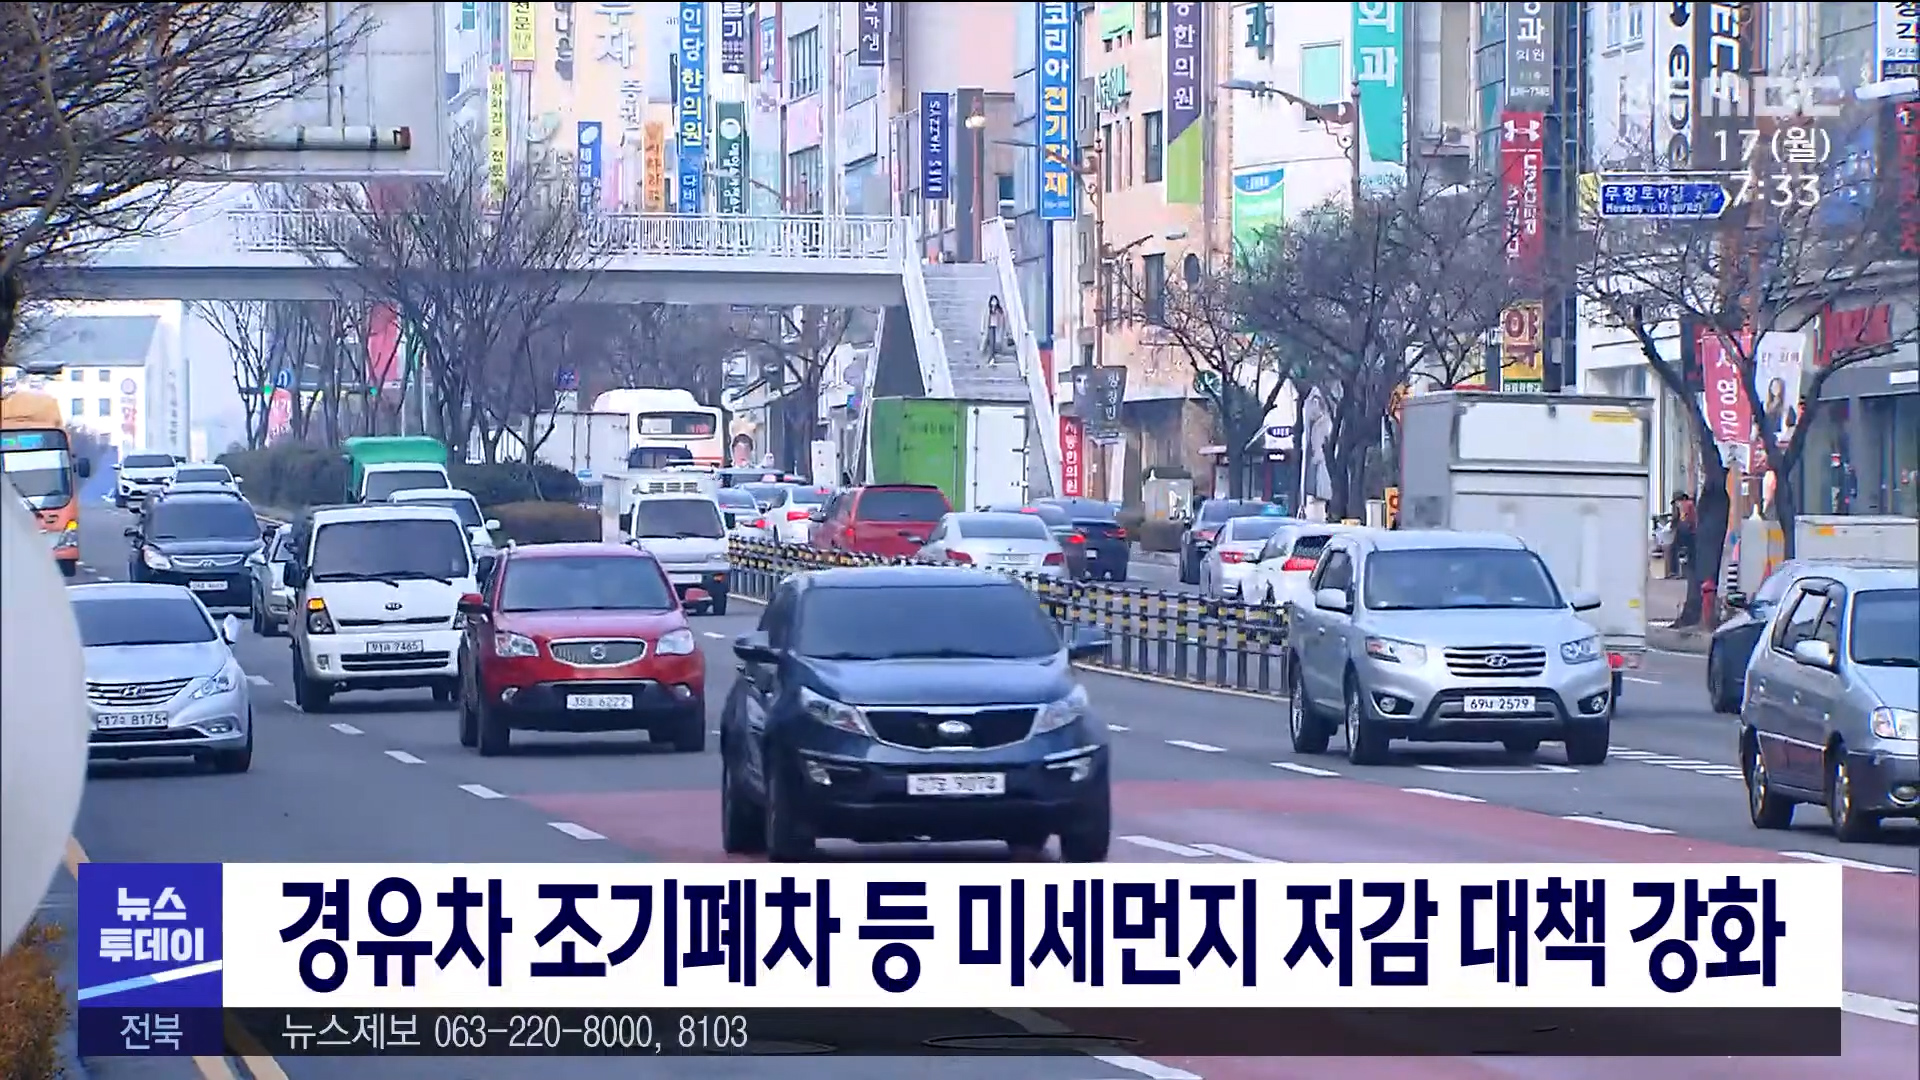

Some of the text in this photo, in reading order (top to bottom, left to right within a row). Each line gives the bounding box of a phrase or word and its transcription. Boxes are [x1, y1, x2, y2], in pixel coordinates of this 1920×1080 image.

[681, 2, 704, 147] 인당한의원
[1498, 698, 1529, 710] 2579
[131, 714, 162, 726] 8175
